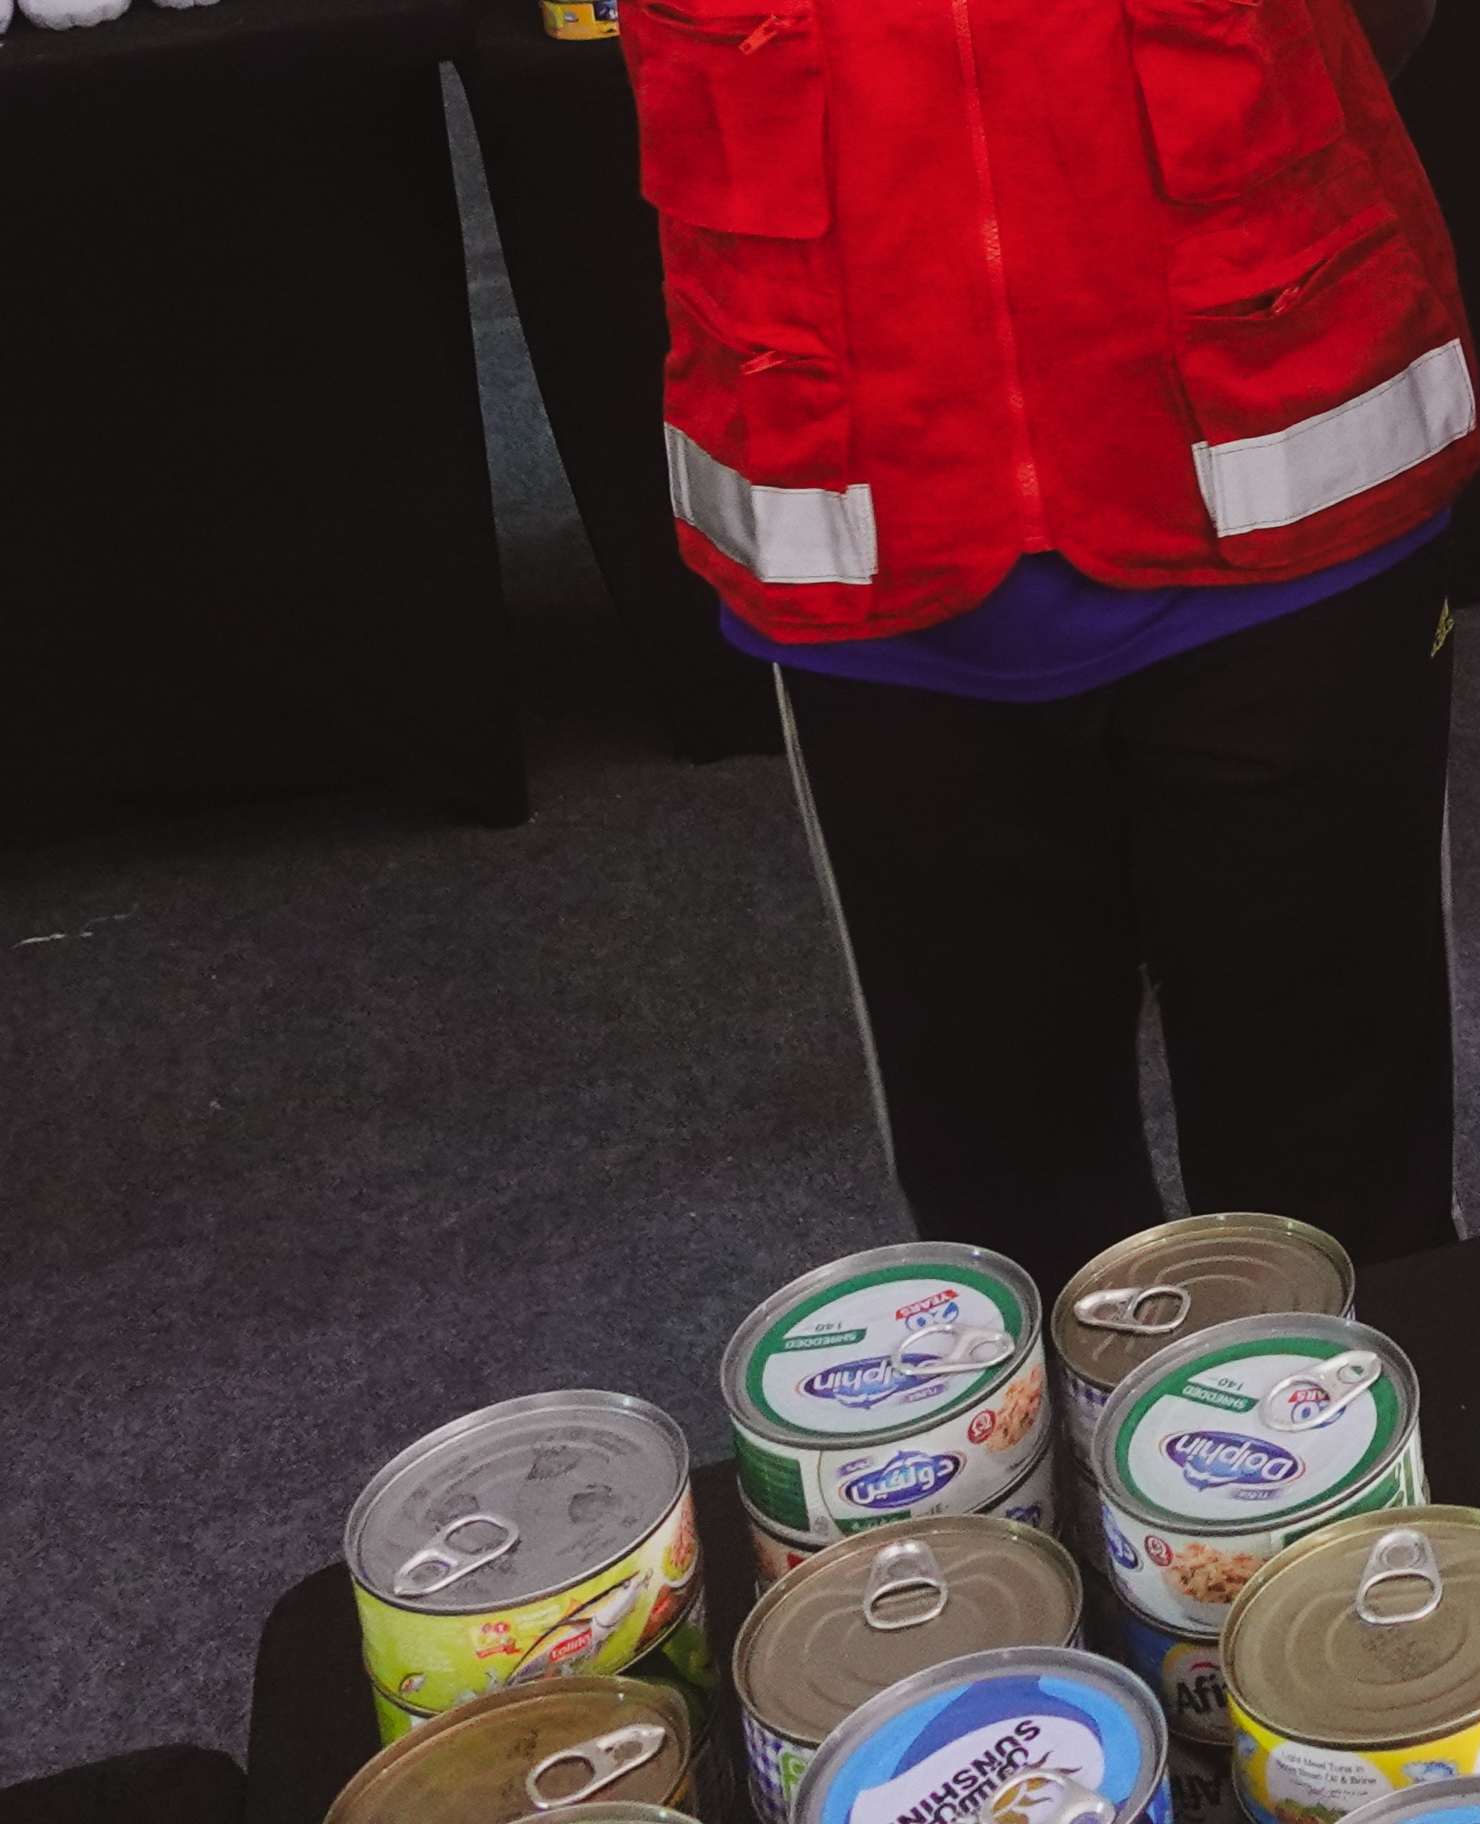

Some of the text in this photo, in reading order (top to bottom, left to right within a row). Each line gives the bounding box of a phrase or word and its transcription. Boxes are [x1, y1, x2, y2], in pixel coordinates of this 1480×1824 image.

[851, 1459, 955, 1503] دولفين
[1175, 1434, 1294, 1481] Dolphin
[890, 1719, 1041, 1824] SUNSHIN
